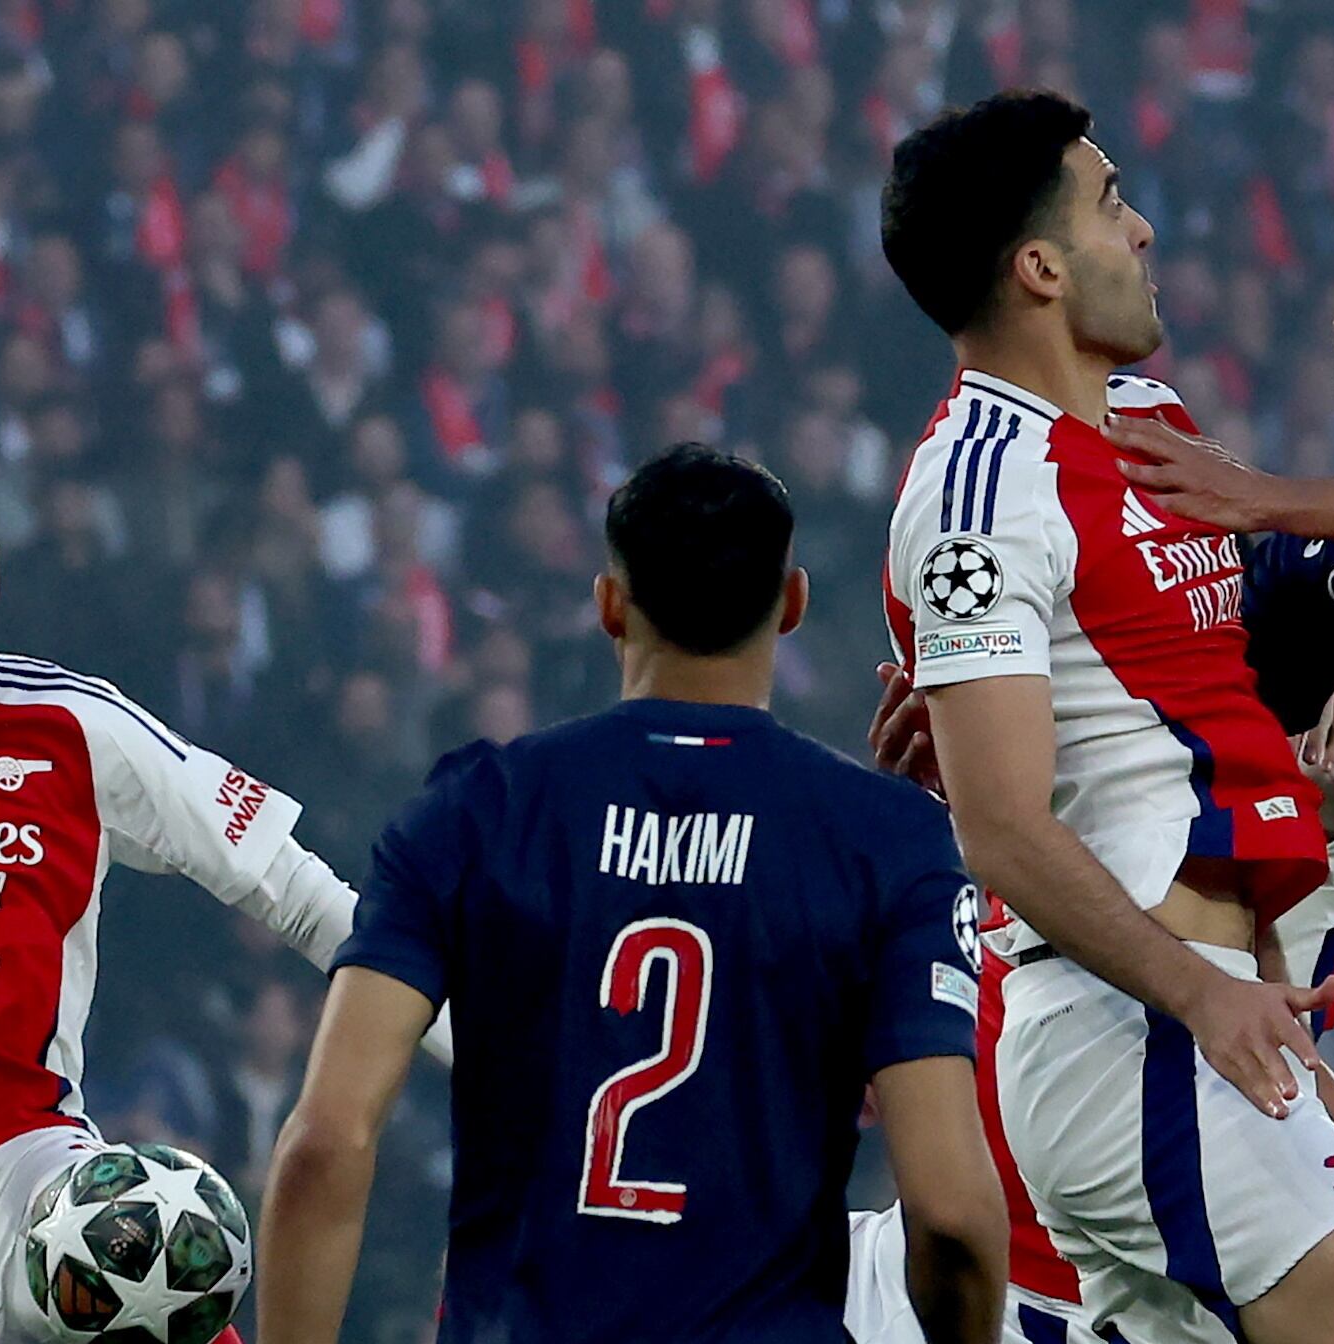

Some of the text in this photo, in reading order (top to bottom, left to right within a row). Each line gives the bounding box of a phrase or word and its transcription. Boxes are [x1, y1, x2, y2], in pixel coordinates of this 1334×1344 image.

[919, 634, 1022, 657] FOUNDATION
[599, 803, 754, 885] HAKIMI
[577, 916, 713, 1224] 2
